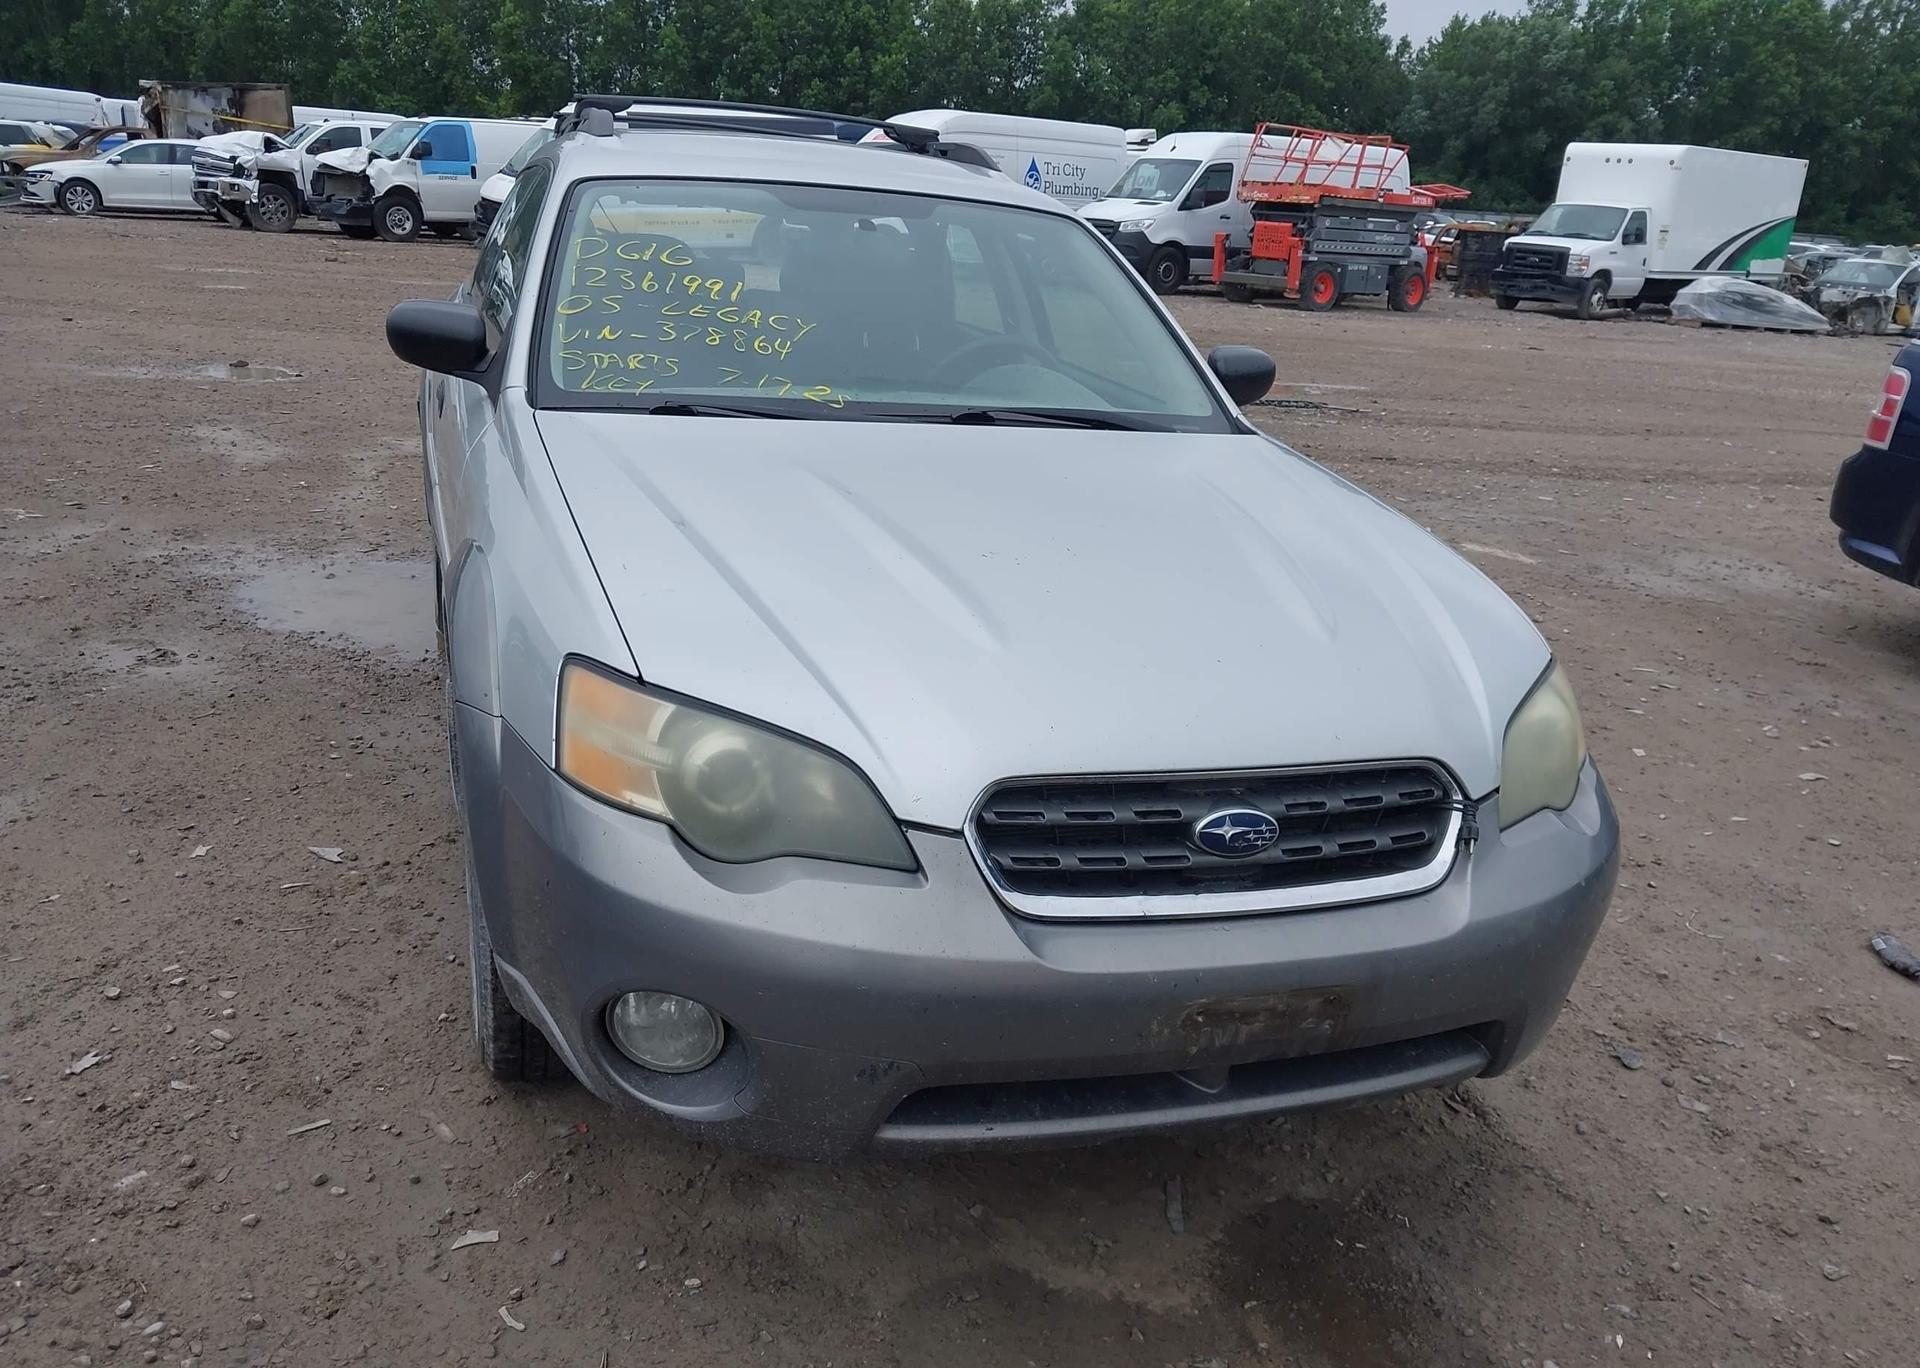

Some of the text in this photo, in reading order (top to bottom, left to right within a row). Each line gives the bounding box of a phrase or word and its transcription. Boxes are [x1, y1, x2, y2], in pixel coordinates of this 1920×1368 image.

[1043, 161, 1087, 181] Tri City
[1043, 180, 1100, 200] Plumbing
[558, 349, 680, 377] STARTS
[580, 367, 655, 396] KEY
